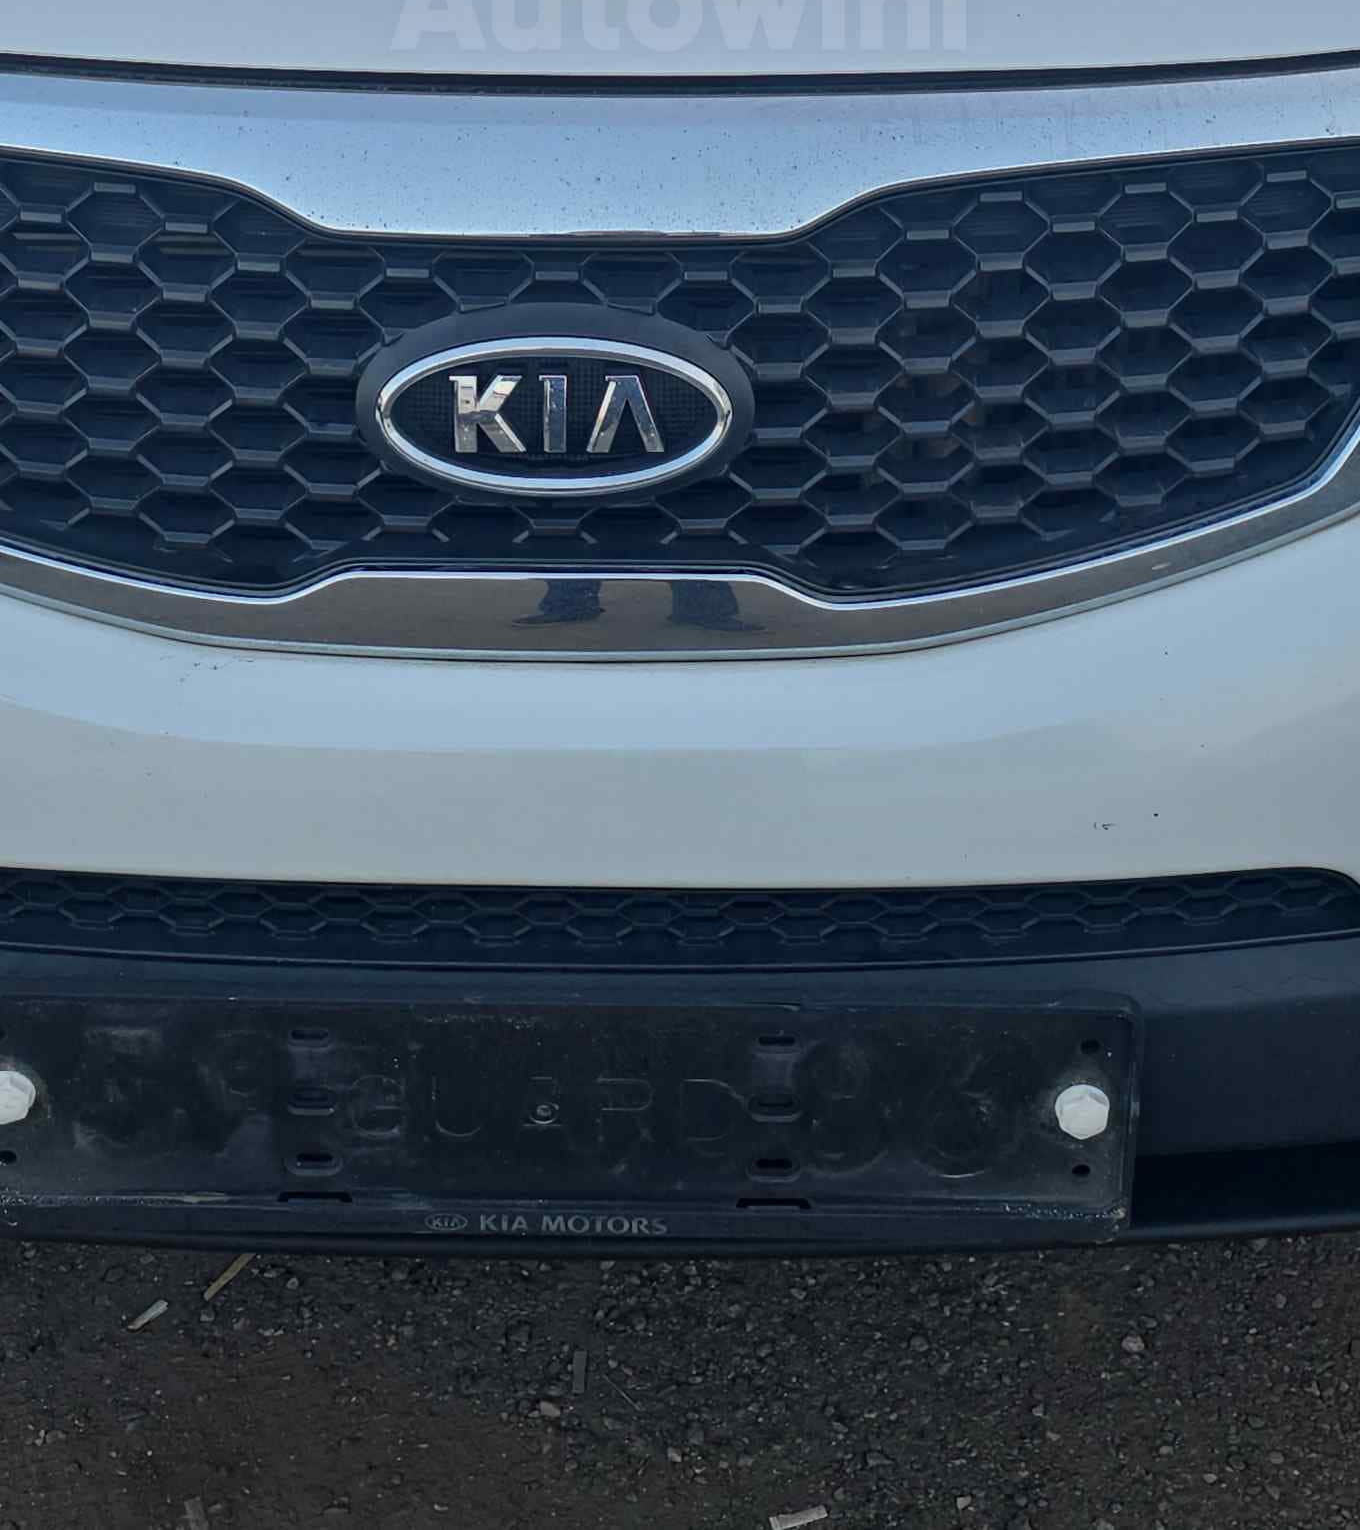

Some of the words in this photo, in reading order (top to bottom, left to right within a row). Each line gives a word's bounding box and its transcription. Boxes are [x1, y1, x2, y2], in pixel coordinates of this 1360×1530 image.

[448, 374, 665, 454] KIA
[479, 1213, 529, 1232] KIA
[540, 1214, 668, 1235] MOTORS
